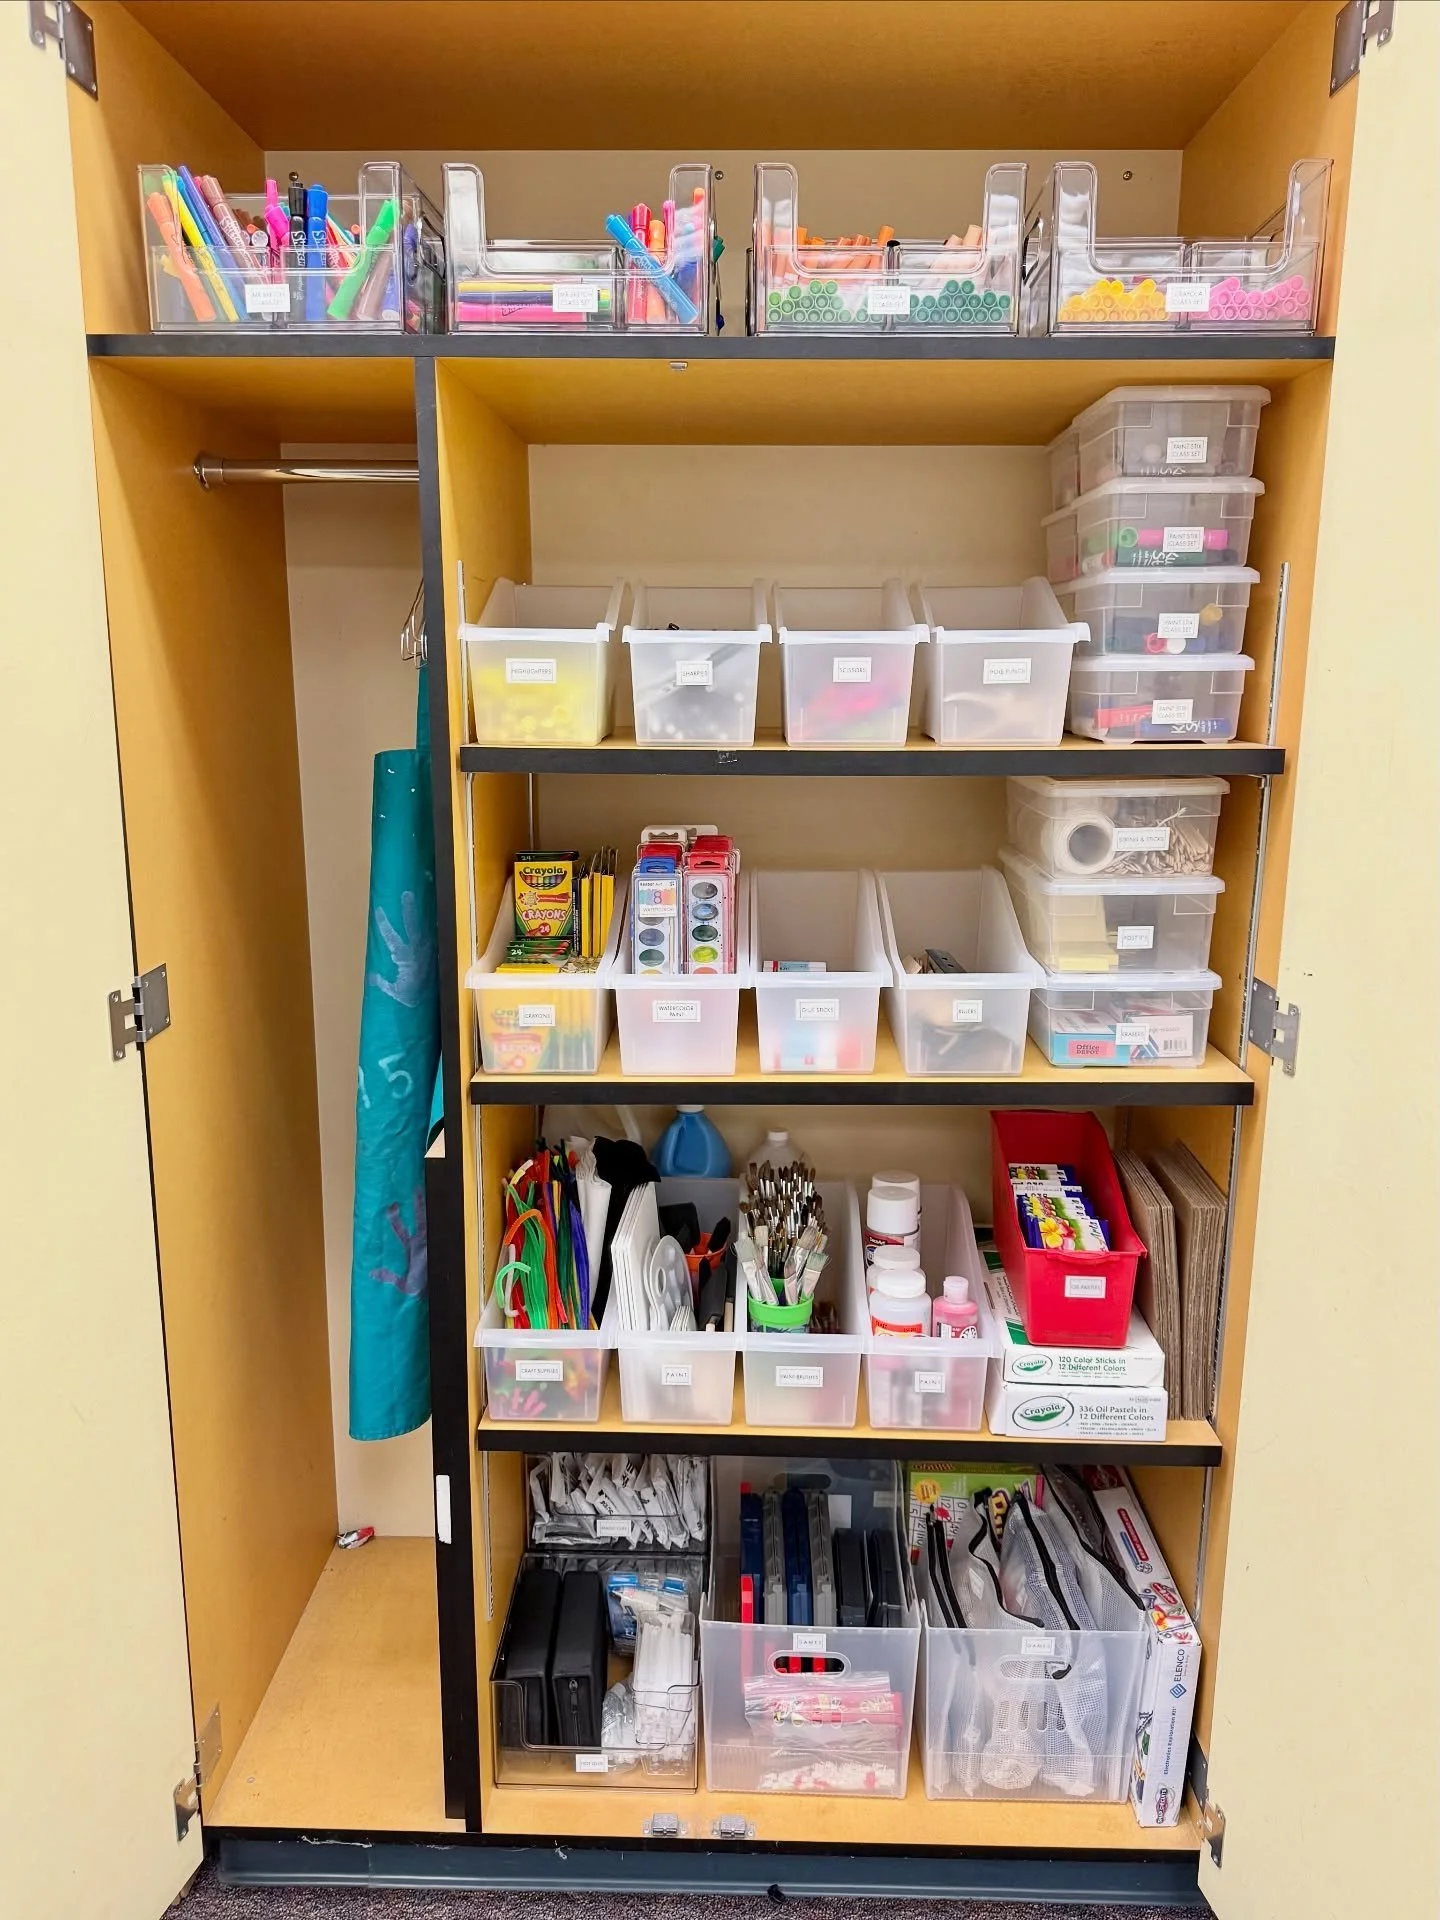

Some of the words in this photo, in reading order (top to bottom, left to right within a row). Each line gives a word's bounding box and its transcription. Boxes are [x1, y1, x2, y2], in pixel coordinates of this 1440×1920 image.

[511, 667, 552, 675] HIGHLIGHTERS
[523, 866, 564, 875] Crayola
[653, 890, 662, 905] 8
[522, 909, 566, 921] CRAYONS
[540, 924, 550, 933] 24
[511, 948, 523, 956] 24
[1074, 1356, 1093, 1364] Color
[1095, 1356, 1116, 1364] Sticks
[1068, 1364, 1100, 1372] Different
[1103, 1365, 1126, 1373] Colors
[1024, 1403, 1061, 1416] Crayola
[1079, 1405, 1093, 1413] 336
[1079, 1413, 1088, 1421] 12
[1090, 1413, 1126, 1421] Different
[1128, 1413, 1154, 1421] Colors
[1174, 1648, 1185, 1682] ELENCO
[1163, 1747, 1171, 1775] Electronics
[1167, 1716, 1175, 1747] Exploration
